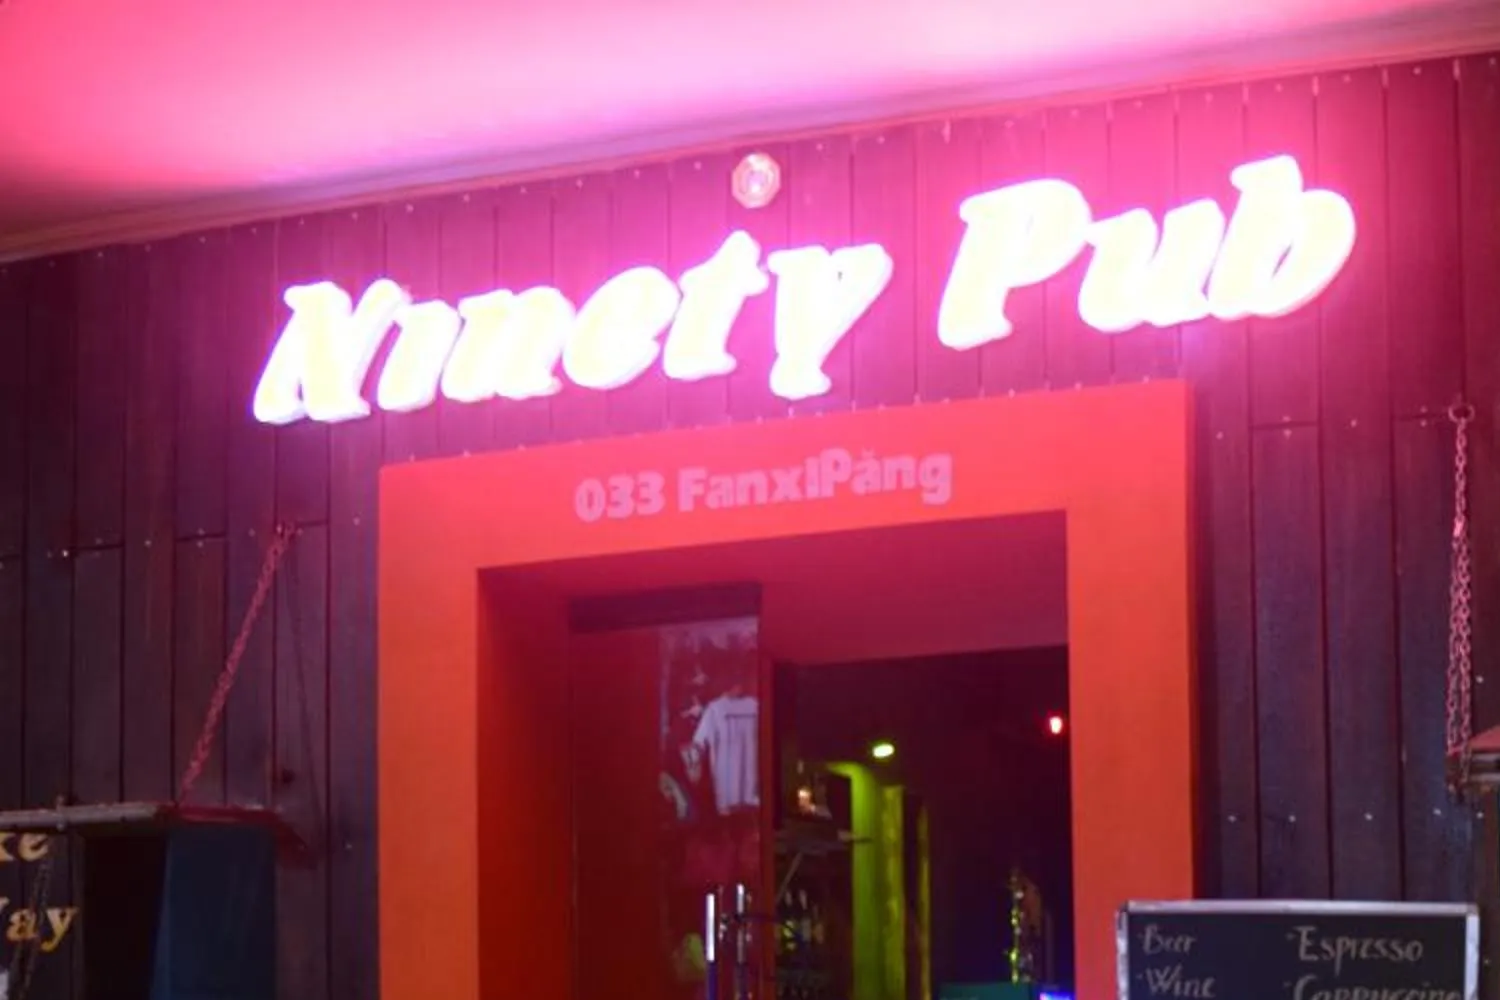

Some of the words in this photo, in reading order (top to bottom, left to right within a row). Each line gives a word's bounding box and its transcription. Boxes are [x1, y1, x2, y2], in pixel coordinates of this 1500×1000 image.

[250, 227, 896, 424] Ninety
[934, 152, 1357, 349] Pub
[573, 471, 666, 523] 033
[1142, 924, 1197, 955] Beer
[1297, 926, 1424, 977] Espresso
[1146, 965, 1216, 998] Wine
